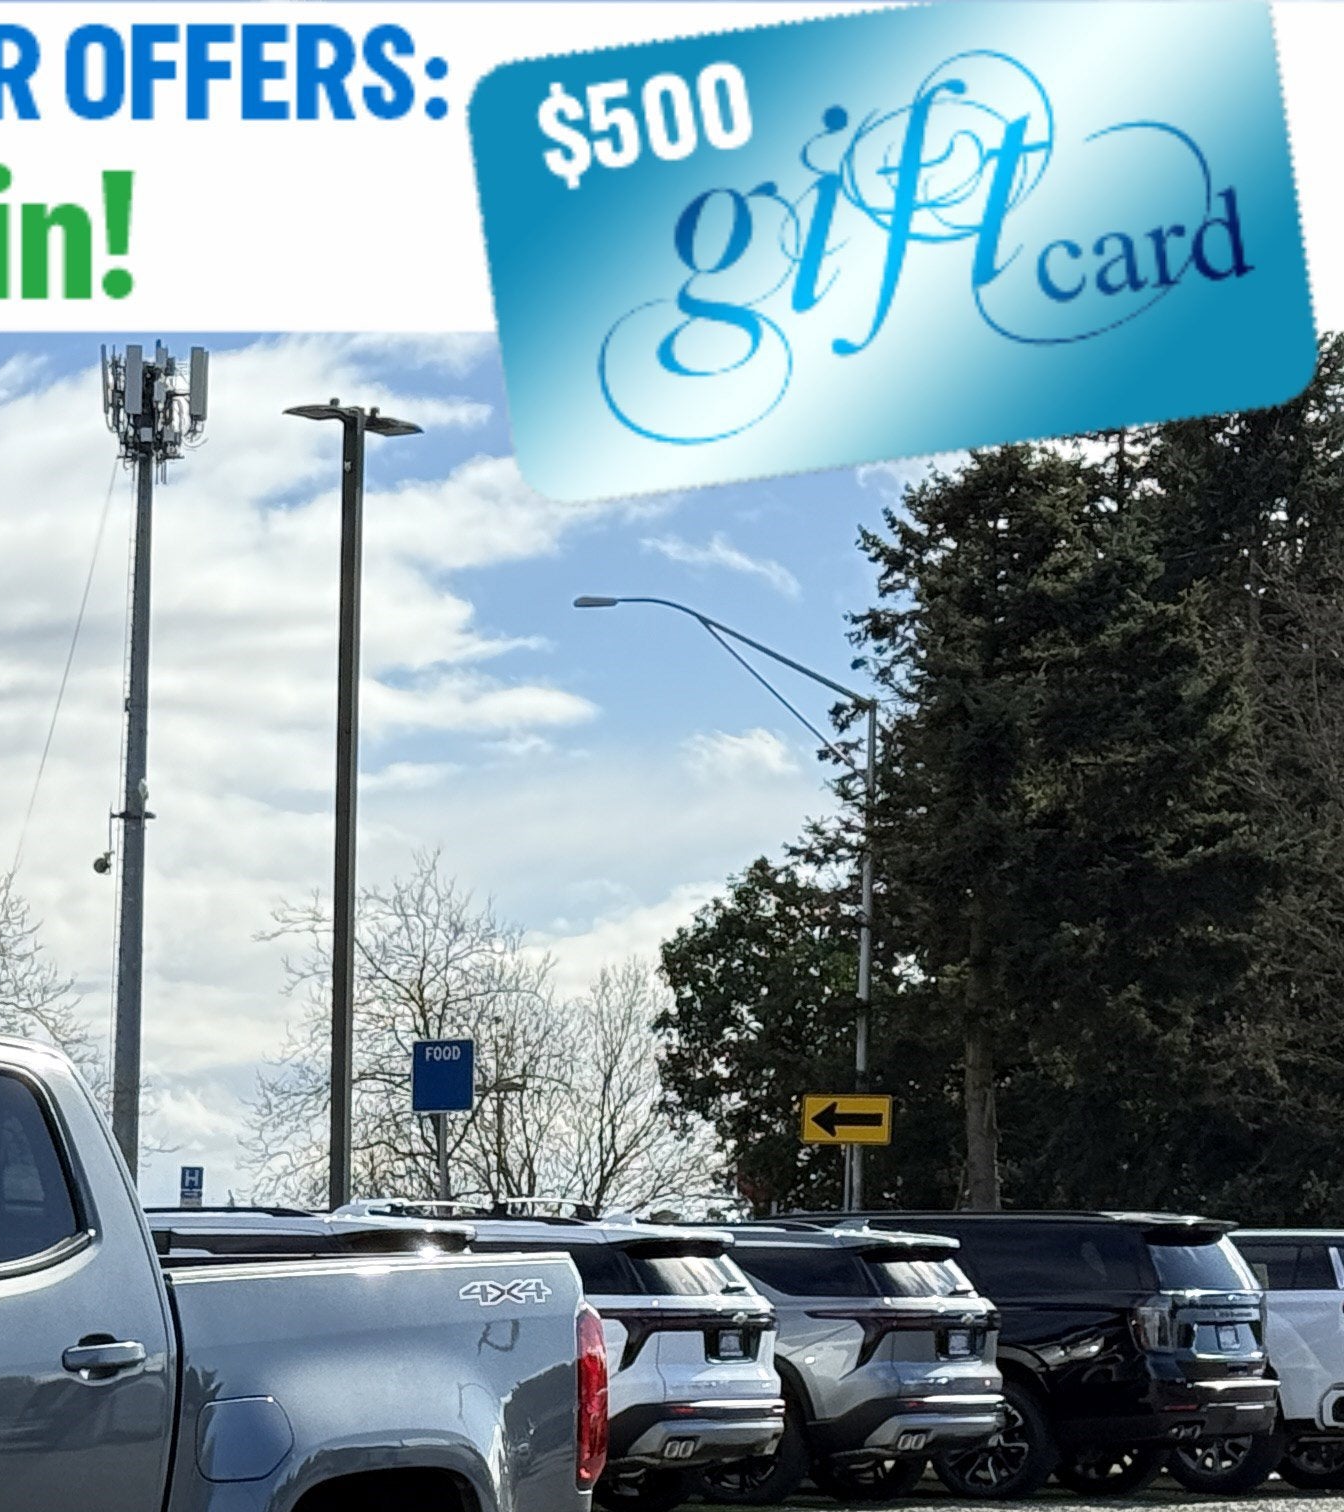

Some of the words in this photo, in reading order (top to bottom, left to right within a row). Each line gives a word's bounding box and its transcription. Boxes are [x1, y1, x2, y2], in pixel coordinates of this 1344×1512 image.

[425, 1045, 461, 1062] FOOD
[184, 1169, 200, 1188] H
[459, 1278, 552, 1306] 4X4
